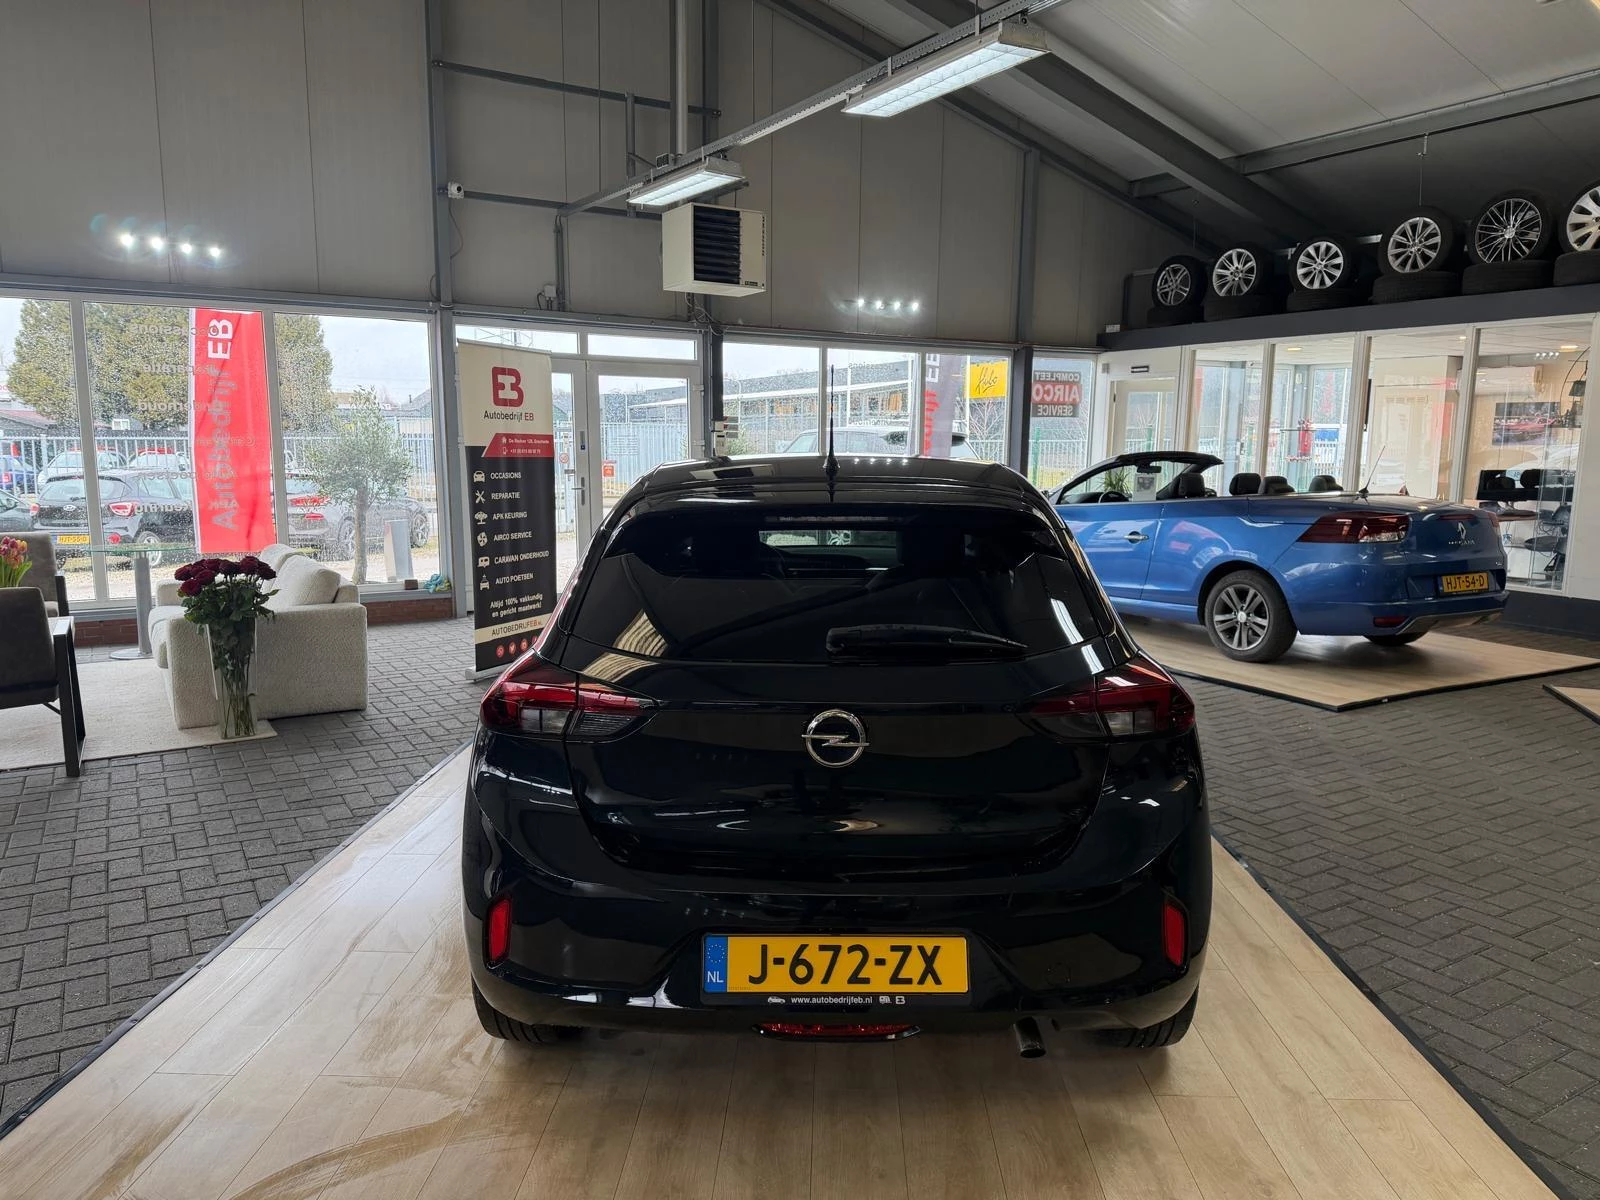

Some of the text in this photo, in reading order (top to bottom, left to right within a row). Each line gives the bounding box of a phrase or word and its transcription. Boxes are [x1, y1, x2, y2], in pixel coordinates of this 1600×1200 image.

[207, 318, 233, 360] EB
[483, 410, 535, 423] Autobedrijf EB
[490, 471, 522, 480] OCCASIONS
[491, 491, 521, 500] REPARATIE
[492, 511, 528, 520] APK KEURING
[493, 531, 532, 541] AIRCO SERVICE
[494, 550, 549, 564] CARAVAN ONDERHOUD
[495, 573, 534, 585] AUTO POETSEN
[1446, 574, 1485, 591] HJT-54-D
[707, 943, 943, 986] NL J-672-ZX
[790, 995, 873, 1006] www.autobedrijfeb.nl
